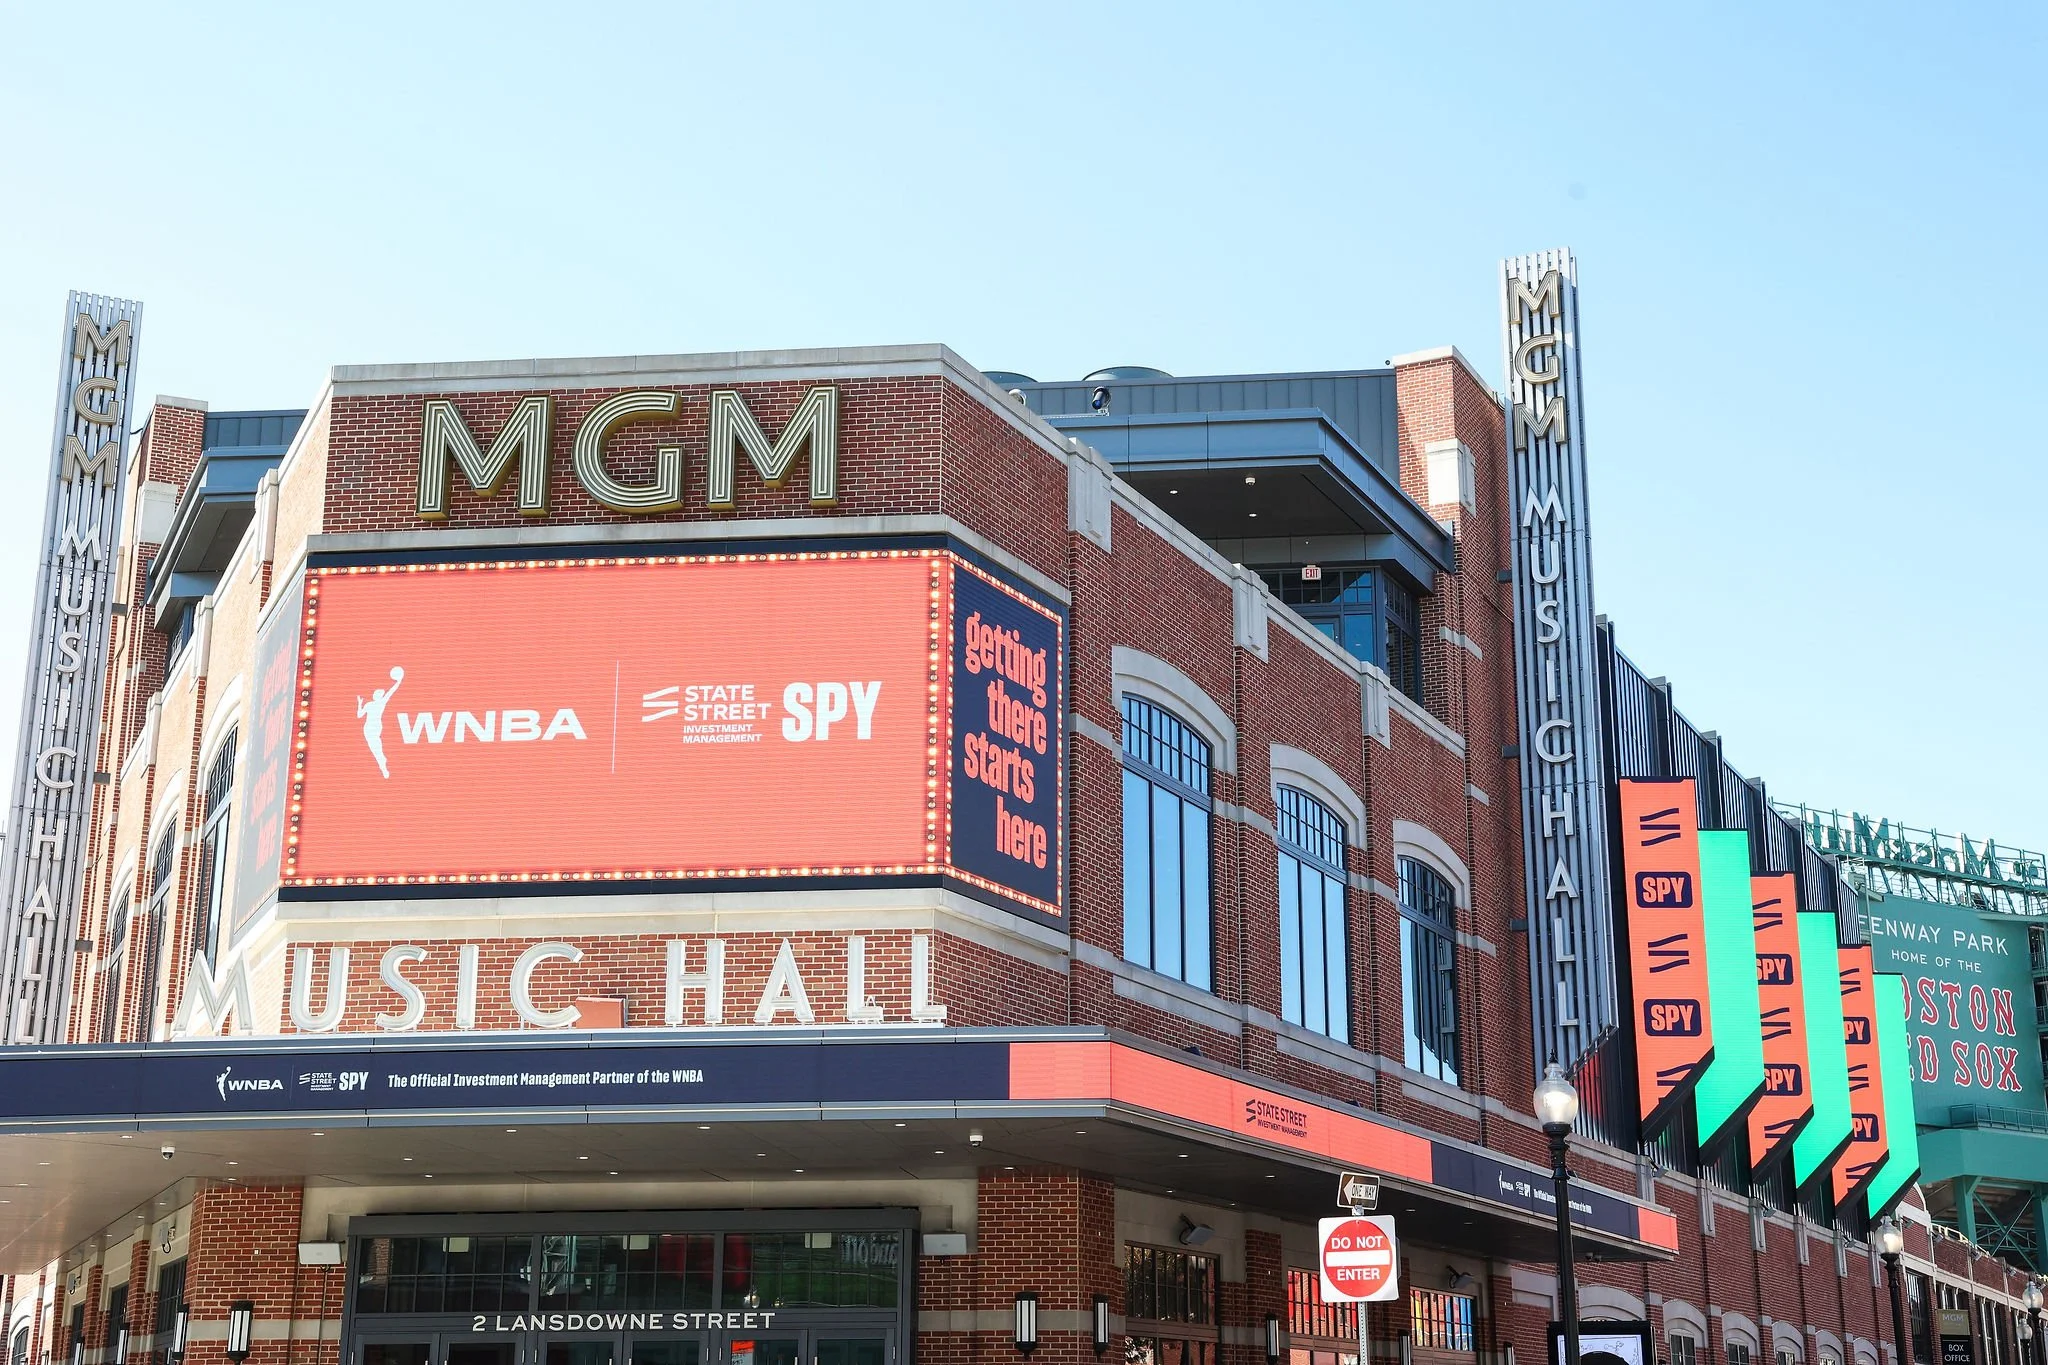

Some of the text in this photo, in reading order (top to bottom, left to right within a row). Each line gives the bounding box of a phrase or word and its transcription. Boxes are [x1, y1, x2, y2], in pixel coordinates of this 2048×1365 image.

[416, 383, 841, 519] MGM
[1305, 568, 1319, 579] EXIT
[1507, 270, 1579, 1027] MGM MUSIC HALL
[965, 611, 1047, 709] getting
[15, 312, 131, 1043] MGM MUSIC HALL
[684, 684, 755, 702] STATE
[684, 703, 772, 722] STREET
[782, 681, 882, 742] SPY
[987, 679, 1047, 755] there
[397, 708, 588, 744] WNBA
[683, 724, 754, 734] INVESTMENT
[682, 733, 763, 744] MANAGEMENT
[964, 731, 1035, 804] starts
[996, 795, 1047, 869] here
[1641, 876, 1685, 903] SPY
[1953, 930, 2009, 956] PARK
[1891, 949, 1982, 973] HOME OF THE
[172, 934, 948, 1032] MUSIC HALL
[1650, 1004, 1694, 1031] SPY
[1844, 1020, 1865, 1040] PY
[1951, 1040, 2022, 1091] SOX
[227, 1079, 284, 1091] WNBA
[310, 1077, 337, 1085] STREET
[339, 1071, 369, 1090] SPY
[388, 1069, 703, 1088] The Official Investment Management Partner of the WNBA
[1257, 1101, 1307, 1128] STATE STREET
[1852, 1117, 1873, 1138] PY
[1352, 1184, 1376, 1199] ONE WAY
[1331, 1236, 1383, 1249] DO NOT
[1337, 1268, 1380, 1281] ENTER
[472, 1313, 775, 1331] 2 LANSDOWNE STREET
[1942, 1314, 1963, 1322] MGM
[1948, 1343, 1964, 1352] BOX
[1944, 1354, 1970, 1362] OFFICE
